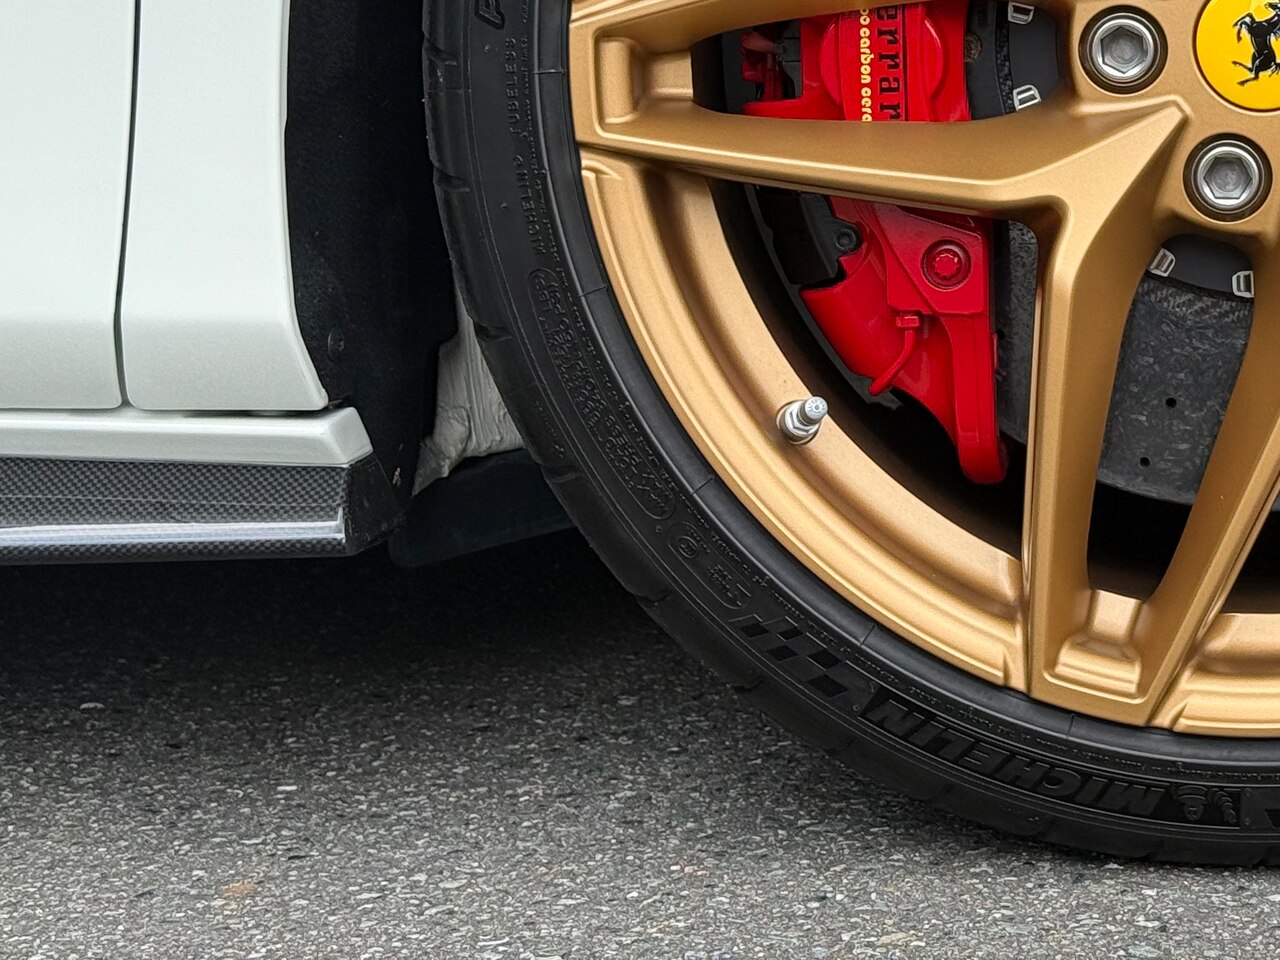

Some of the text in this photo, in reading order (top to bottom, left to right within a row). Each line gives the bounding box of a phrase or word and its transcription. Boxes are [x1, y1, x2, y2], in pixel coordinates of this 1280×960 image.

[503, 37, 521, 134] TUBELESS
[859, 86, 873, 122] cera
[876, 5, 902, 121] errar
[867, 698, 1163, 816] MICHELIN
